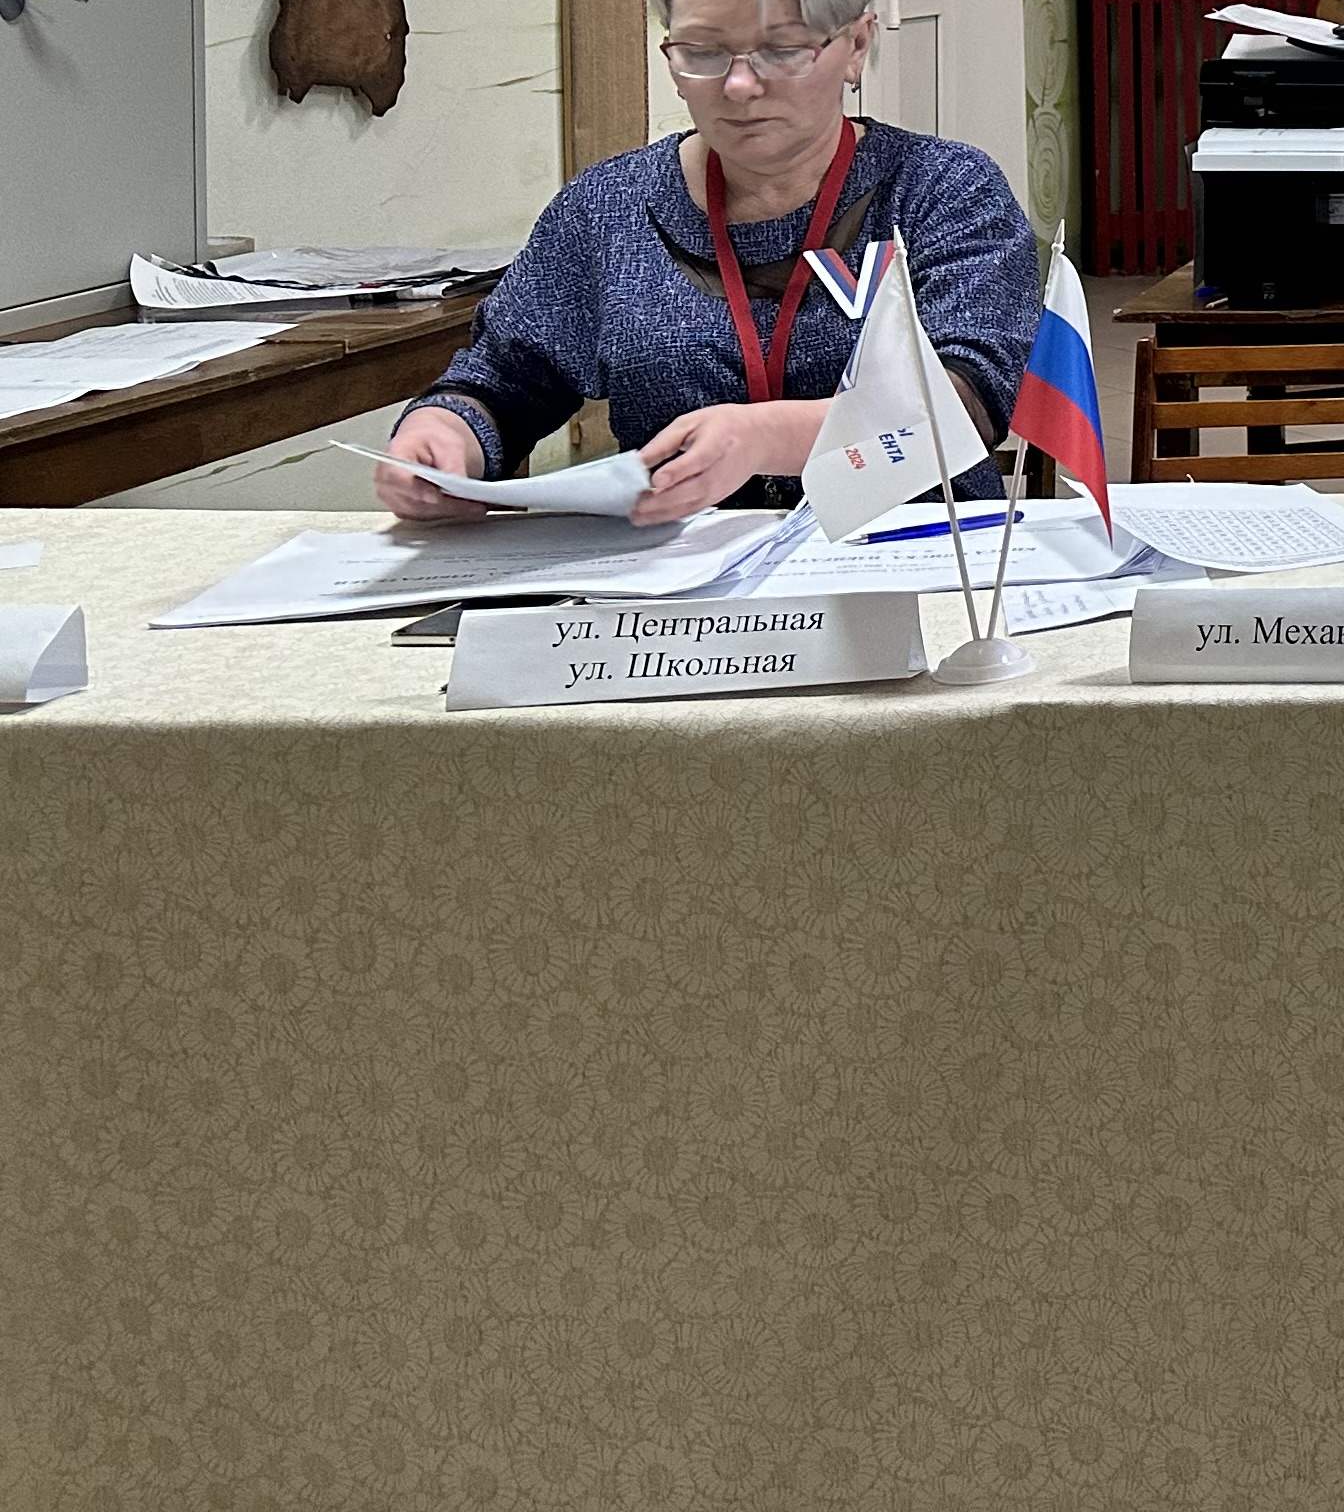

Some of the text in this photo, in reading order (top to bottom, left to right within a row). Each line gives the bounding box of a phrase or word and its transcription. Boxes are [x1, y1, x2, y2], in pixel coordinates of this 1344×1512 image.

[845, 448, 866, 469] 2024
[878, 433, 905, 464] ЕНТА
[552, 611, 825, 647] ул. Центральная
[1195, 624, 1240, 652] ул.
[565, 652, 797, 688] ул. Школьная
